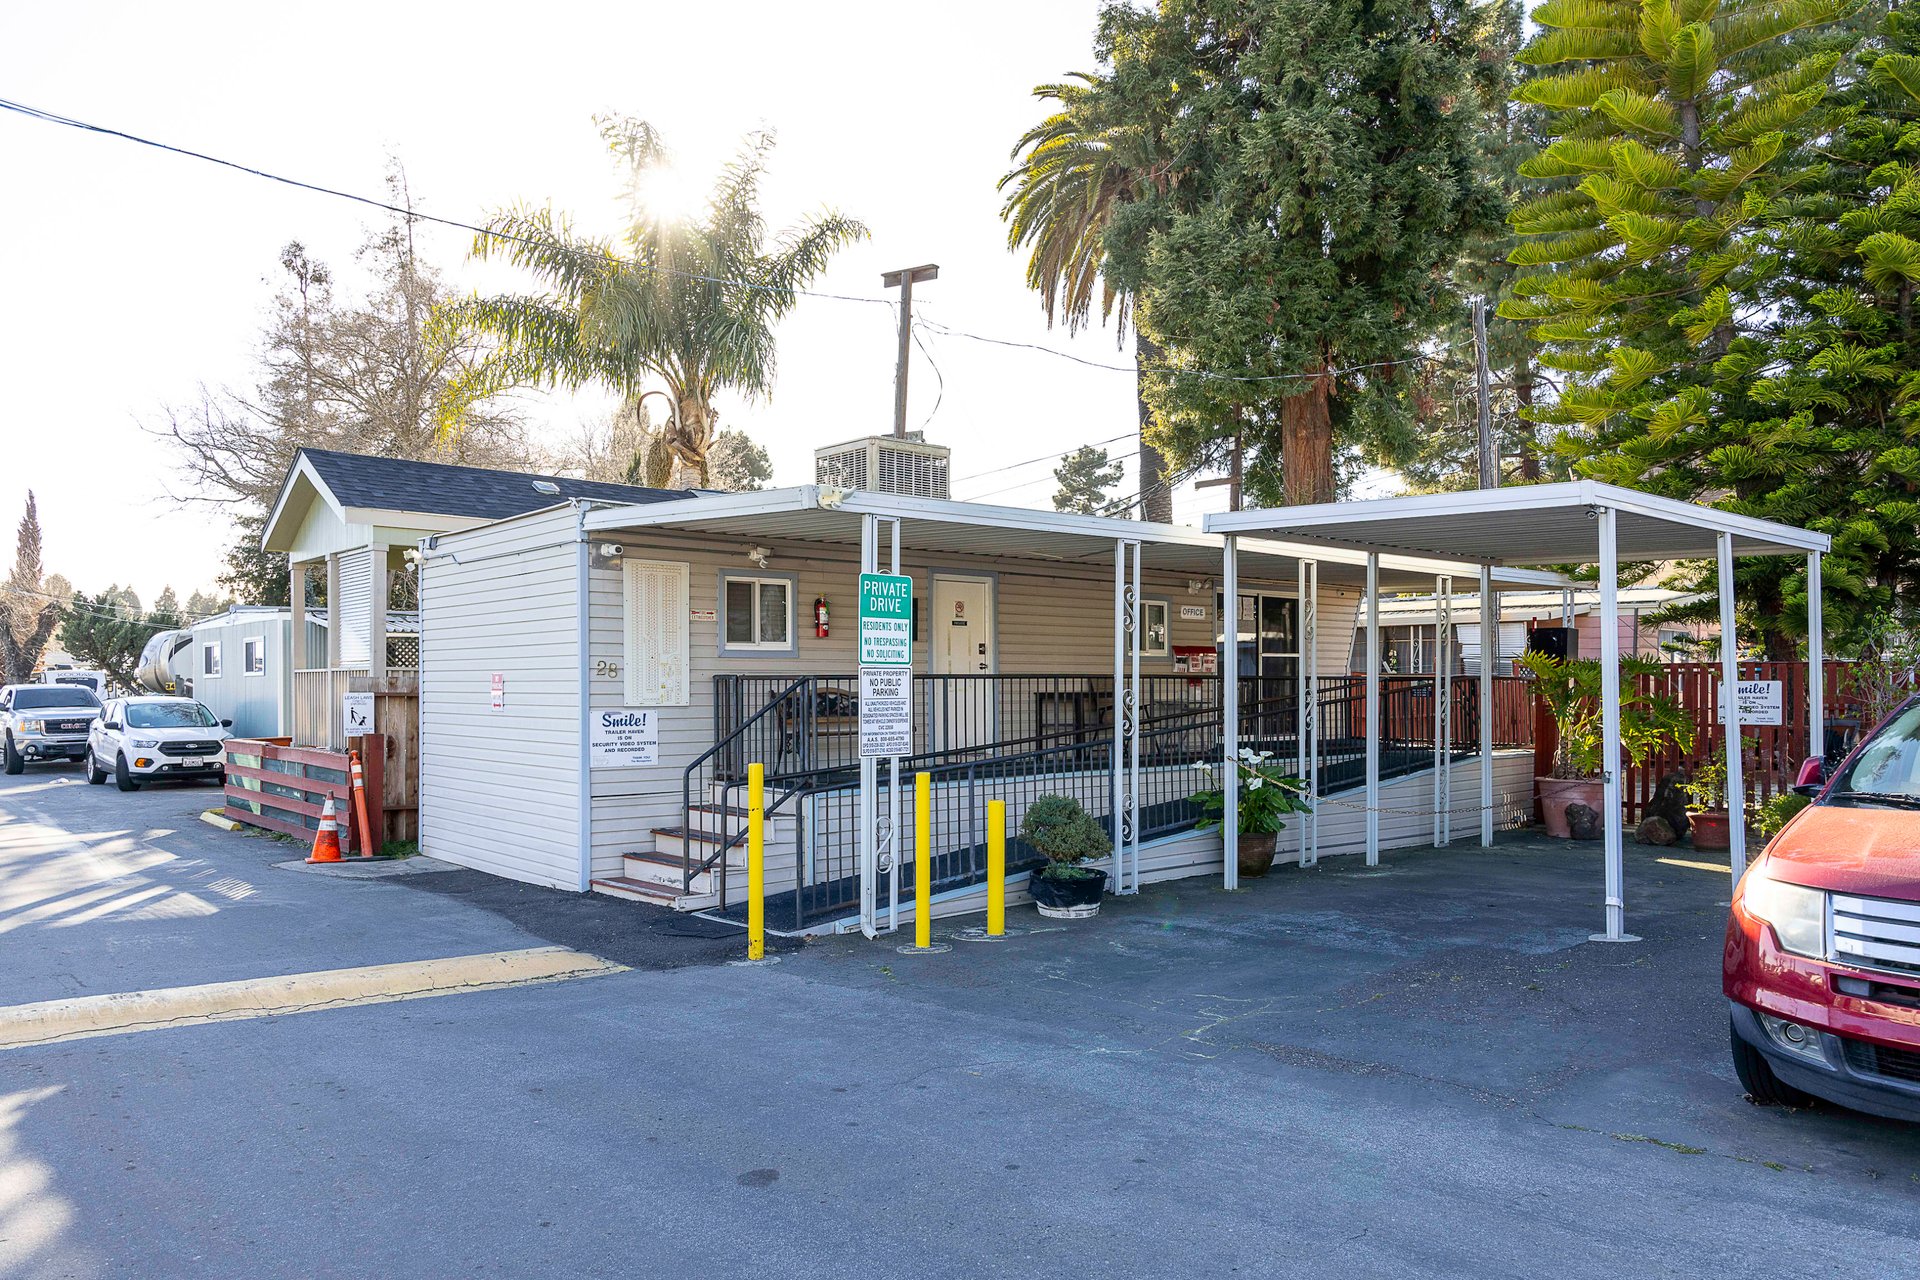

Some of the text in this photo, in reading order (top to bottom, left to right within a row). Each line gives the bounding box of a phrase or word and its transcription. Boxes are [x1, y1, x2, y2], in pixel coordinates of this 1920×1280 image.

[864, 581, 908, 597] PRIVATE
[870, 597, 902, 613] DRIVE
[1182, 608, 1204, 616] OFFICE
[863, 621, 908, 632] RESIDENTS ONLY
[864, 637, 907, 647] NO TRESPASSING
[866, 649, 905, 659] NO SOLICITING
[596, 660, 618, 679] 28
[869, 678, 902, 687] NO PUBLIC
[872, 688, 899, 697] PARKING
[1737, 683, 1770, 694] mile!
[602, 713, 646, 727] Smile!
